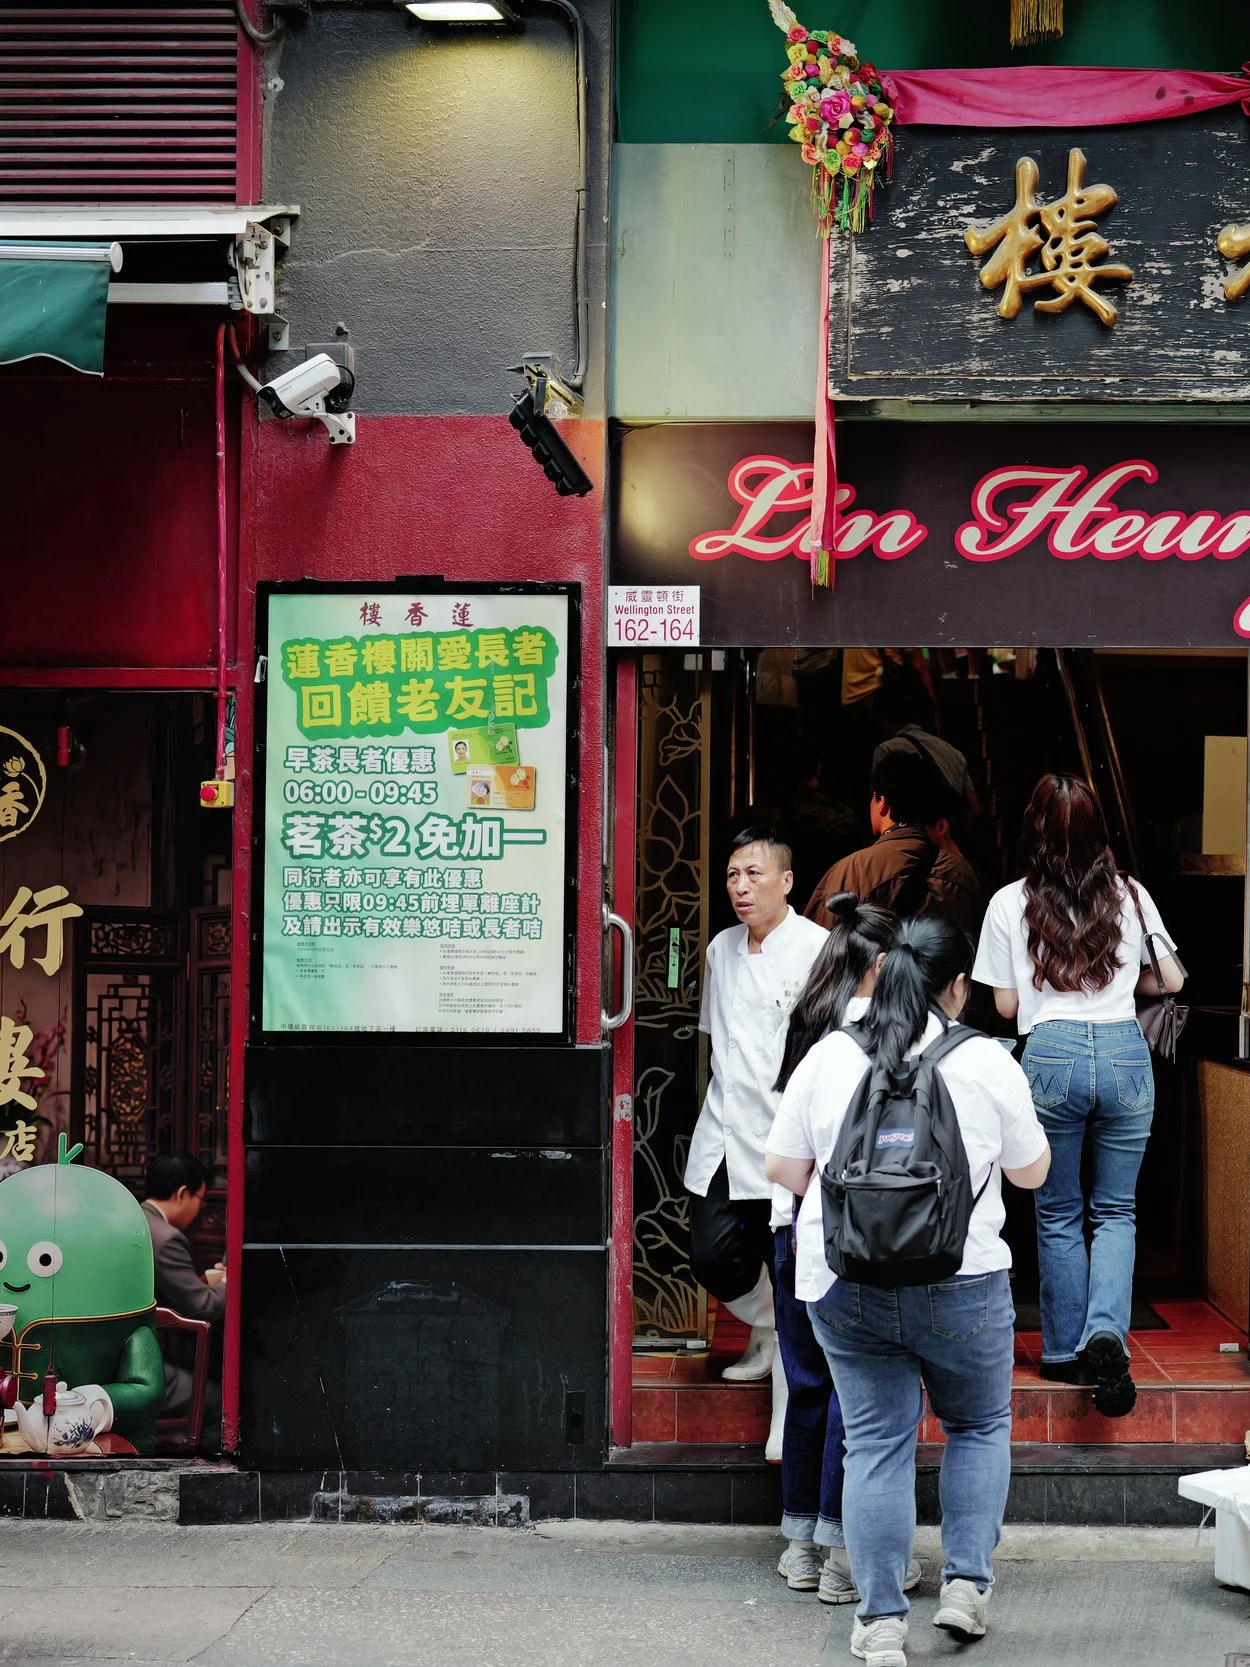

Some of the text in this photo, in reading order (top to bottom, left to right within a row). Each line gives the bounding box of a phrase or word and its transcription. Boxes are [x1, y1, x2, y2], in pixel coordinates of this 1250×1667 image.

[625, 590, 684, 602] 威靈頓街
[615, 604, 695, 616] Wellington Street
[614, 619, 694, 641] 162-164
[286, 631, 547, 680] 蓮香樓關愛長者
[301, 673, 538, 727] 回饋老友記
[283, 745, 436, 775] 早茶長者優惠
[282, 866, 483, 889] 同行者亦可享有此優惠
[281, 890, 542, 915] 優惠只限09:45前埋單離座計
[280, 915, 543, 940] 及請出示有效樂悠咭或長者咭
